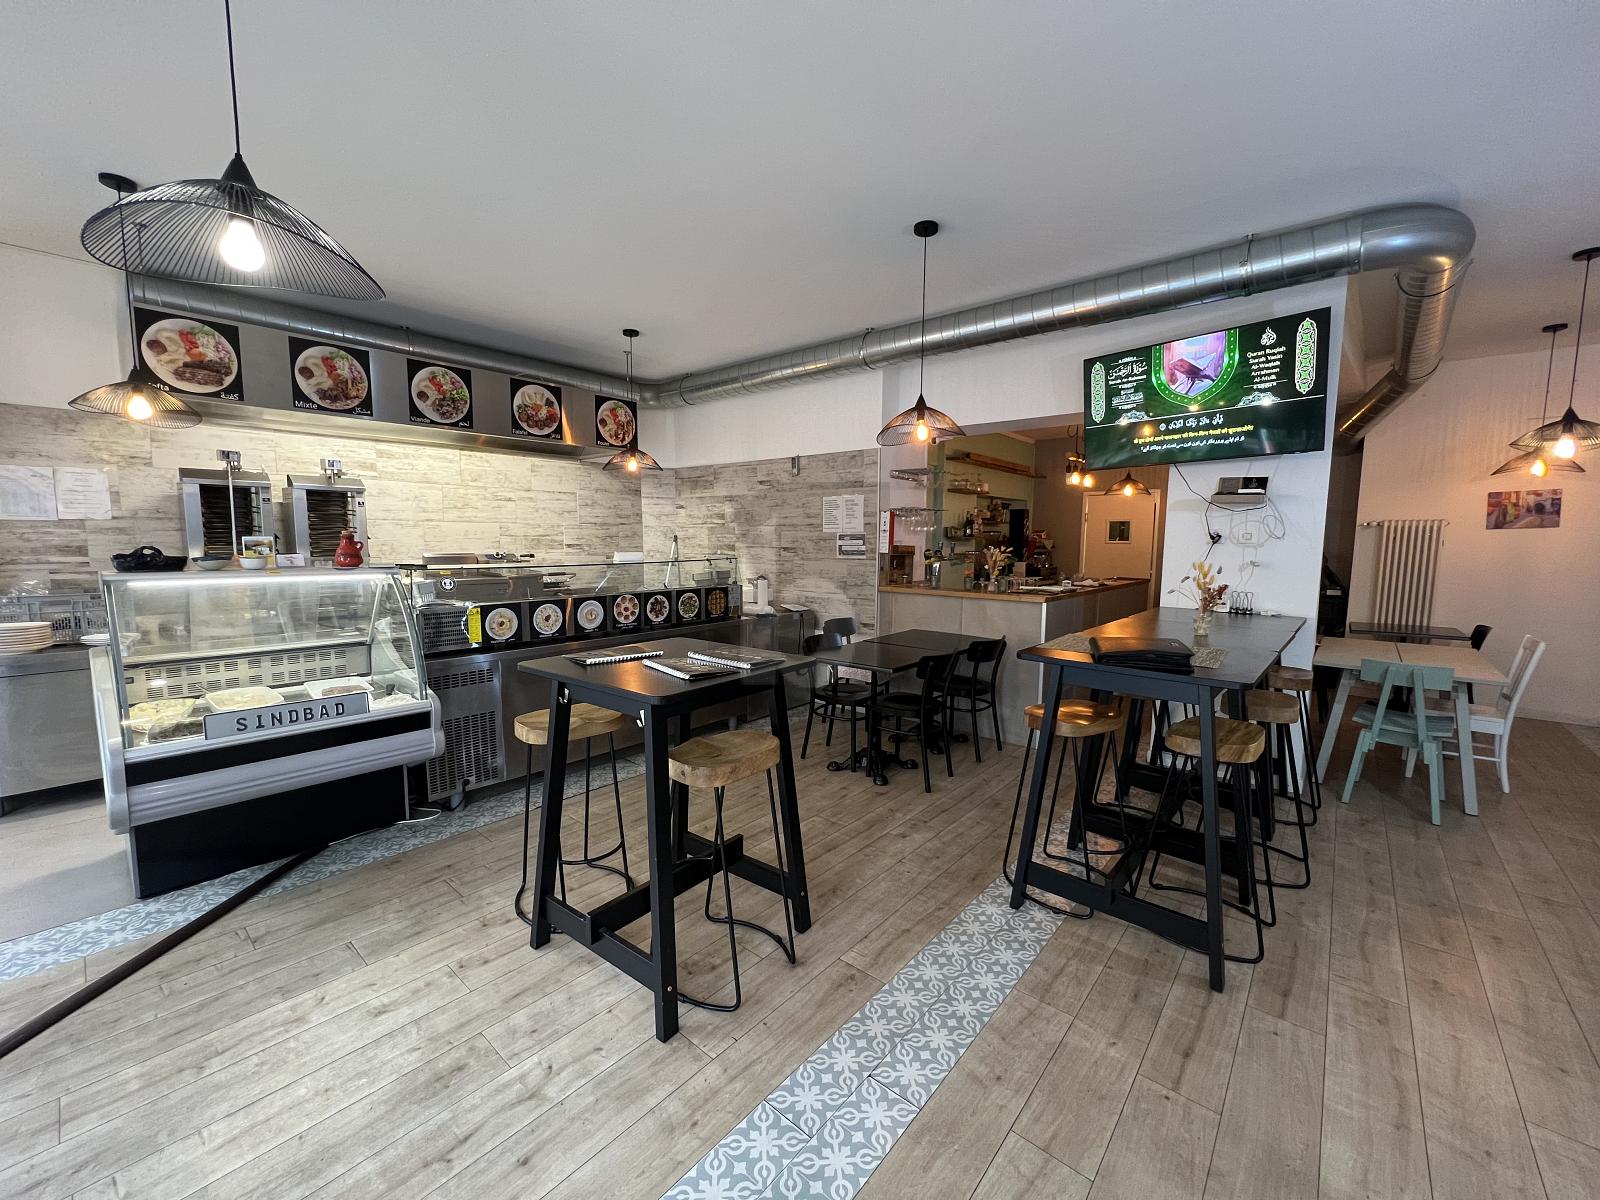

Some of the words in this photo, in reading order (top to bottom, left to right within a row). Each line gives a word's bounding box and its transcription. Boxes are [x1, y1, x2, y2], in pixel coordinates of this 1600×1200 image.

[295, 400, 318, 410] Mixte
[410, 415, 431, 424] Viande
[235, 702, 346, 732] SINDBAD
